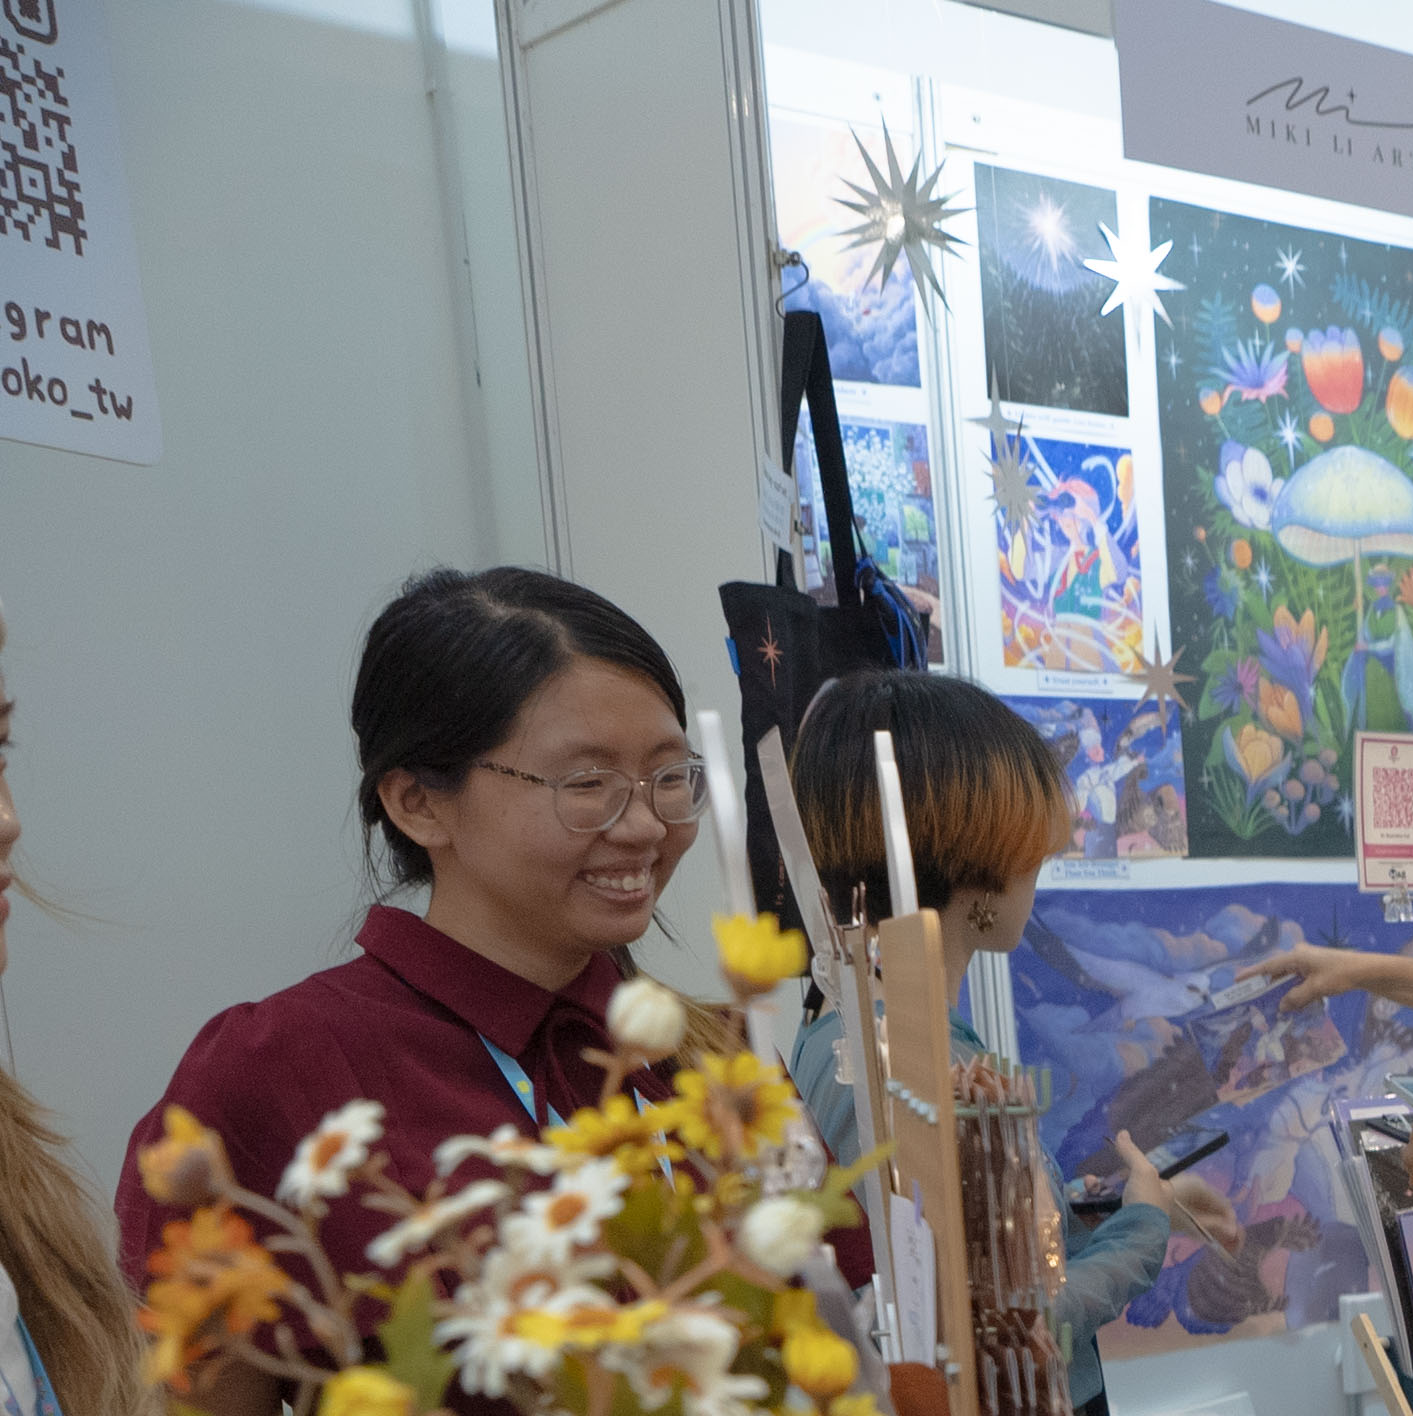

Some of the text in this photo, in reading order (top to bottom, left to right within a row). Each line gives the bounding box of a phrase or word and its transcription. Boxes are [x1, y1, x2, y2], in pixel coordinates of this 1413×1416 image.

[1246, 114, 1311, 147] MIKI
[1333, 134, 1352, 156] LI
[0, 301, 114, 356] gram
